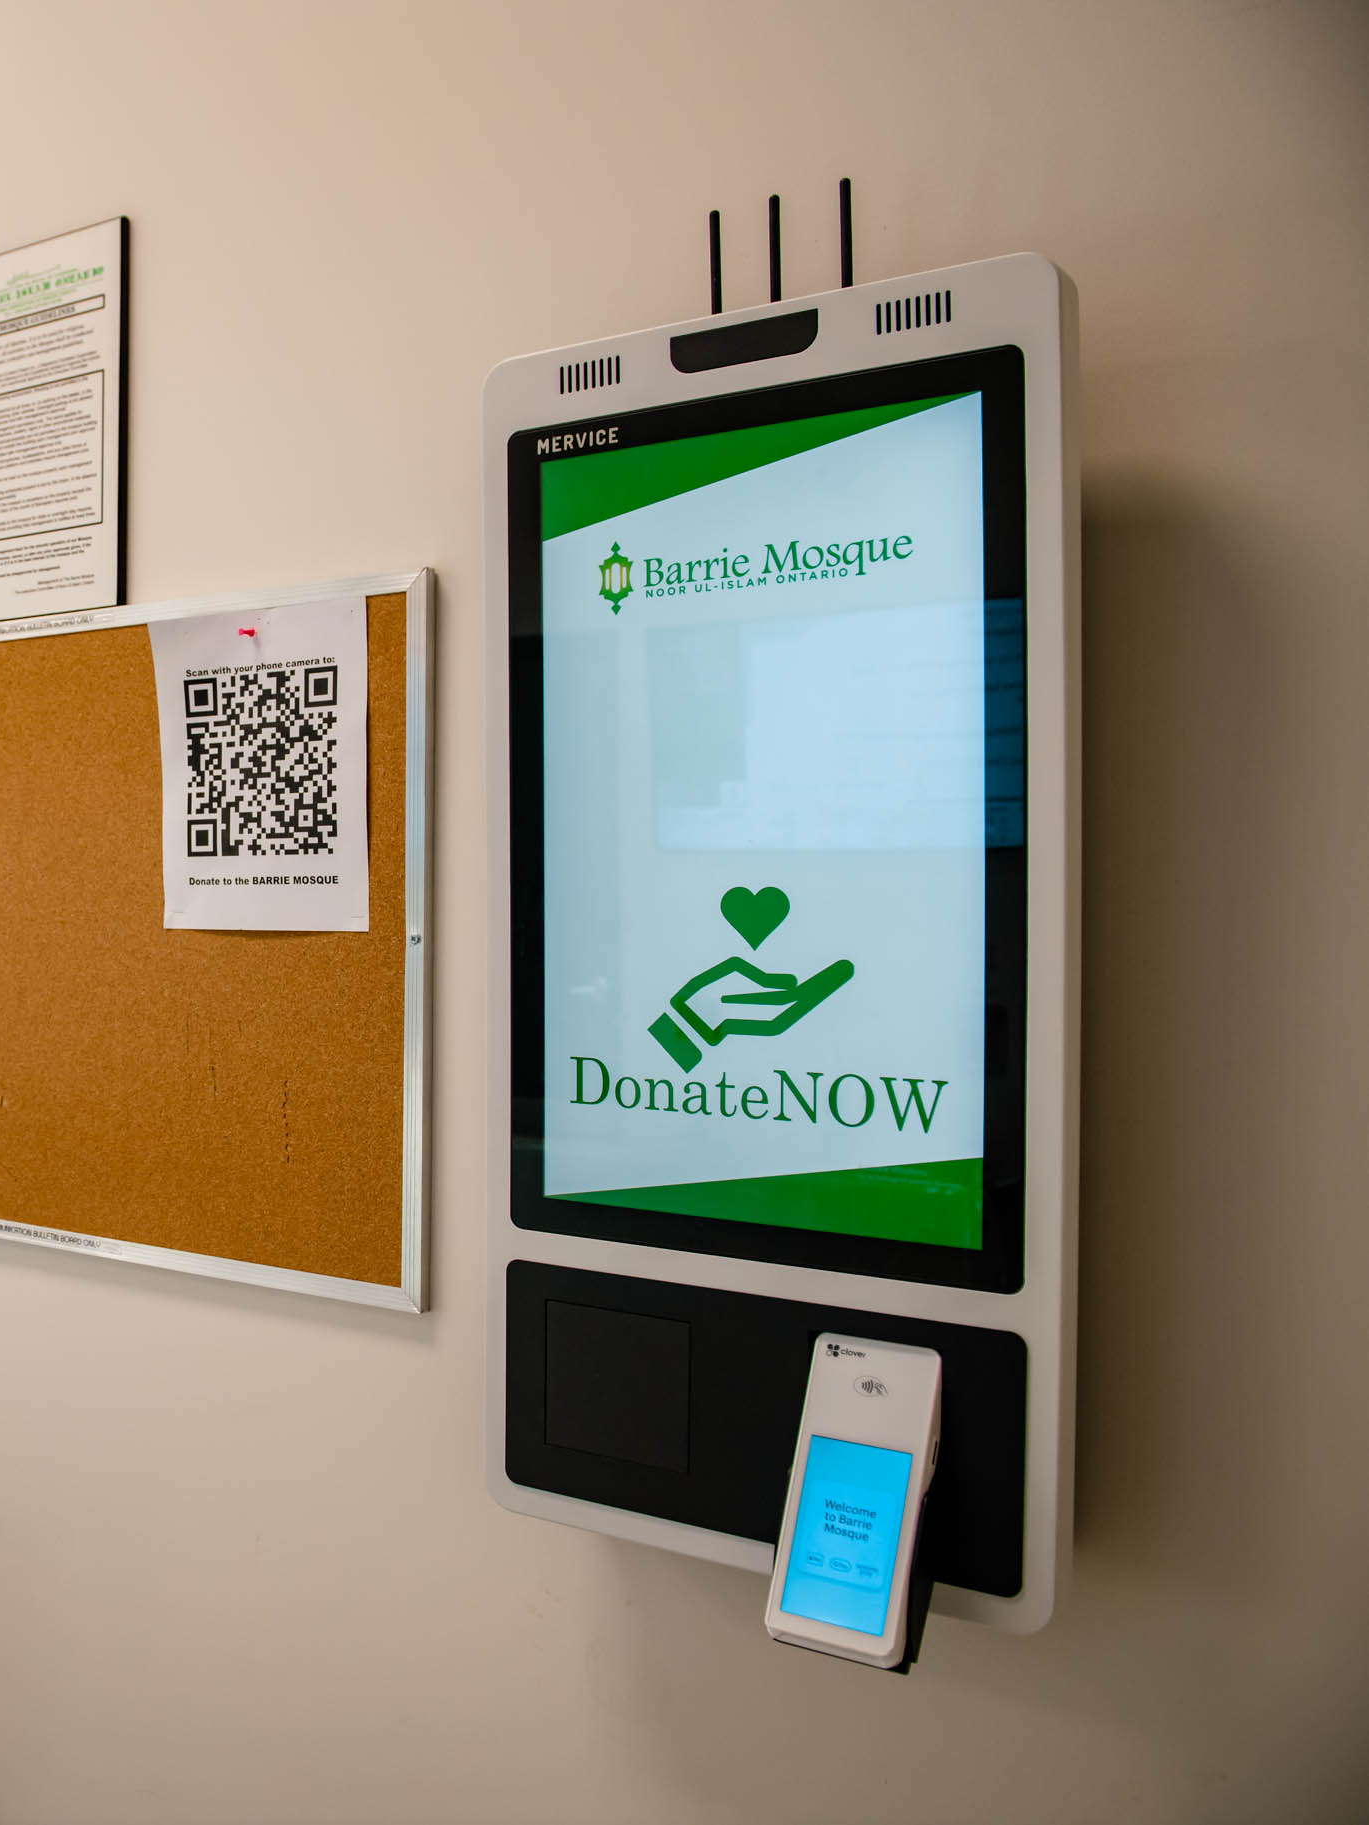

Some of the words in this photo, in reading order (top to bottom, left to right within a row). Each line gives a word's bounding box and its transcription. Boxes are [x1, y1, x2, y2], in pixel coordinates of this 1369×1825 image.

[537, 426, 619, 455] MERVICE
[643, 546, 751, 588] Barrie
[761, 534, 914, 577] Mosque
[645, 585, 687, 598] NOOR
[694, 576, 768, 593] UL-ISLAM
[775, 567, 849, 584] ONTARIO
[185, 669, 209, 678] Scan
[211, 666, 232, 676] with
[234, 665, 254, 674] your
[255, 660, 283, 673] phone
[285, 657, 320, 668] camera
[322, 656, 336, 664] to:
[189, 877, 220, 886] Donate
[223, 877, 232, 885] to
[235, 876, 250, 885] the
[252, 876, 290, 885] BARRIE
[293, 875, 340, 885] MOSQUE
[83, 1238, 102, 1249] ONLY
[840, 1347, 866, 1359] clover
[824, 1498, 878, 1520] Welcome
[825, 1511, 837, 1522] to
[838, 1513, 873, 1530] Barrie
[823, 1522, 870, 1541] Mosque
